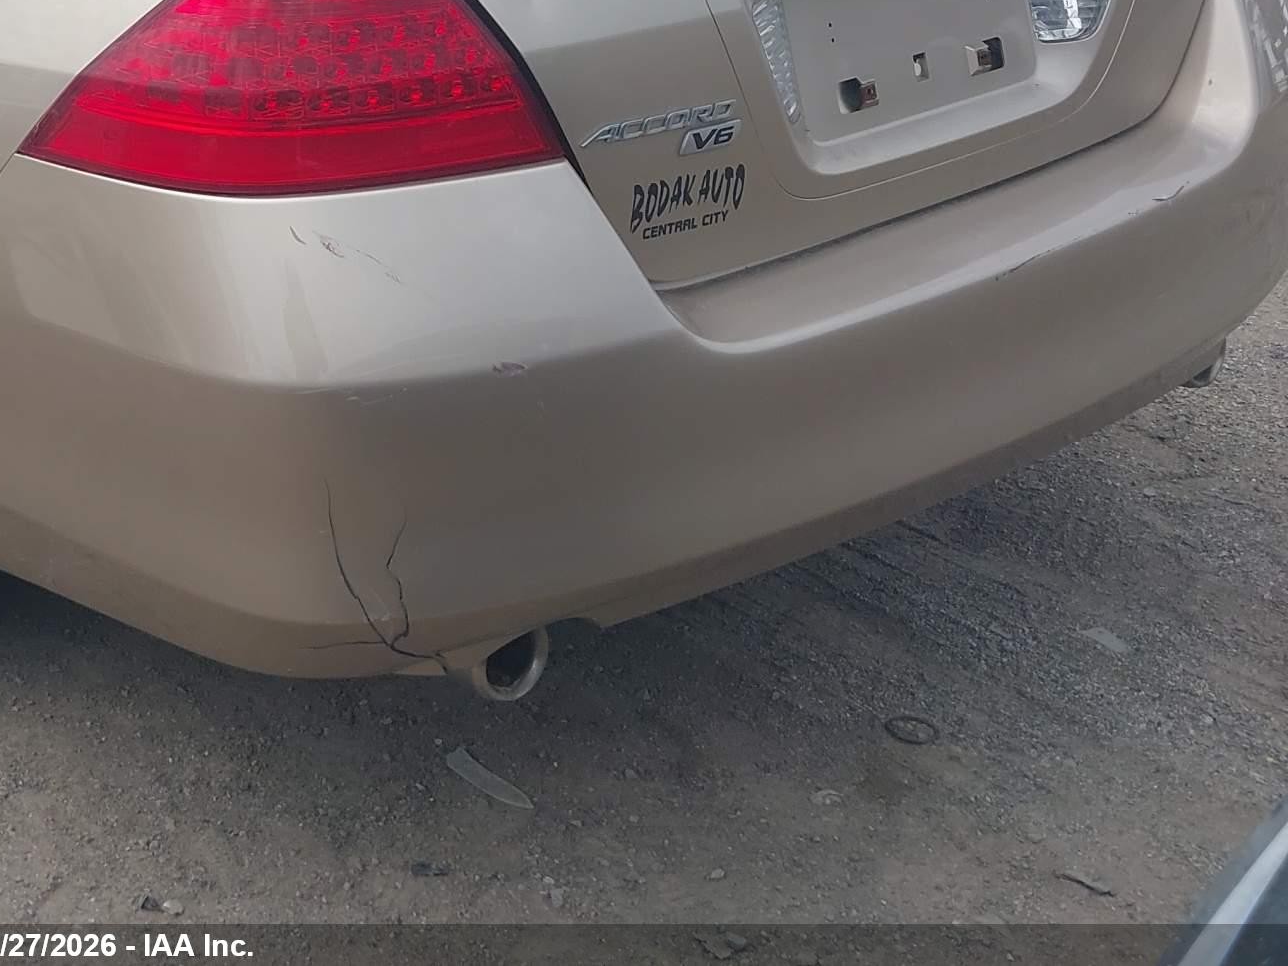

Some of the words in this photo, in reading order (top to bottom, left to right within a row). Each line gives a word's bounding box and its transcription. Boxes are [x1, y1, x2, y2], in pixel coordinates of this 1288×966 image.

[580, 99, 737, 148] ACCORD
[692, 126, 735, 151] V6
[630, 173, 696, 234] BODAK
[698, 163, 746, 210] AUTO
[642, 217, 698, 240] CENTRAL
[702, 210, 729, 227] CITY
